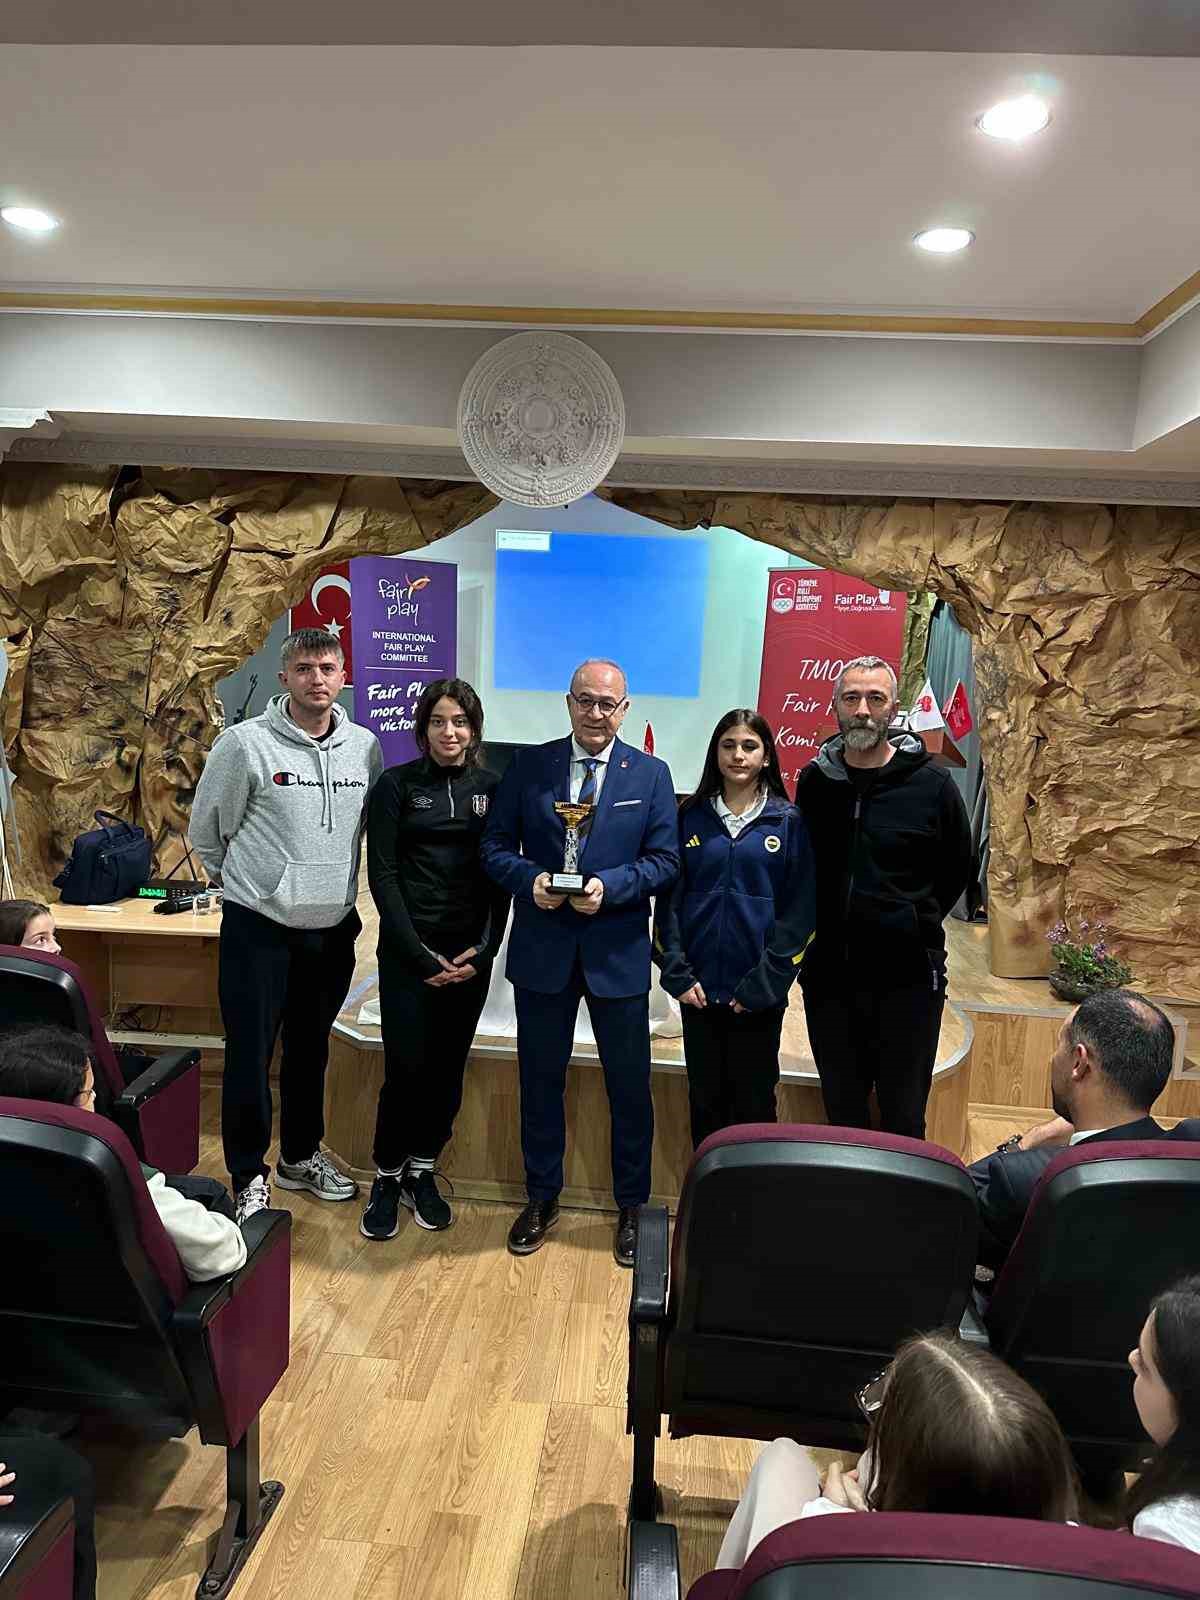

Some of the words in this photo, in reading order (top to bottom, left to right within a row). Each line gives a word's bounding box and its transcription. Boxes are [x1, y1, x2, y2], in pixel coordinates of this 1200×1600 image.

[835, 594, 855, 604] Fair
[855, 593, 878, 606] Play
[388, 599, 419, 626] play
[372, 631, 436, 643] INTERNATIONAL
[384, 642, 403, 651] FAIR
[404, 644, 425, 653] PLAY
[381, 653, 428, 663] COMMITTEE
[367, 682, 402, 701] Fair
[370, 703, 405, 719] more
[781, 693, 821, 713] Fair
[774, 725, 819, 749] Komi
